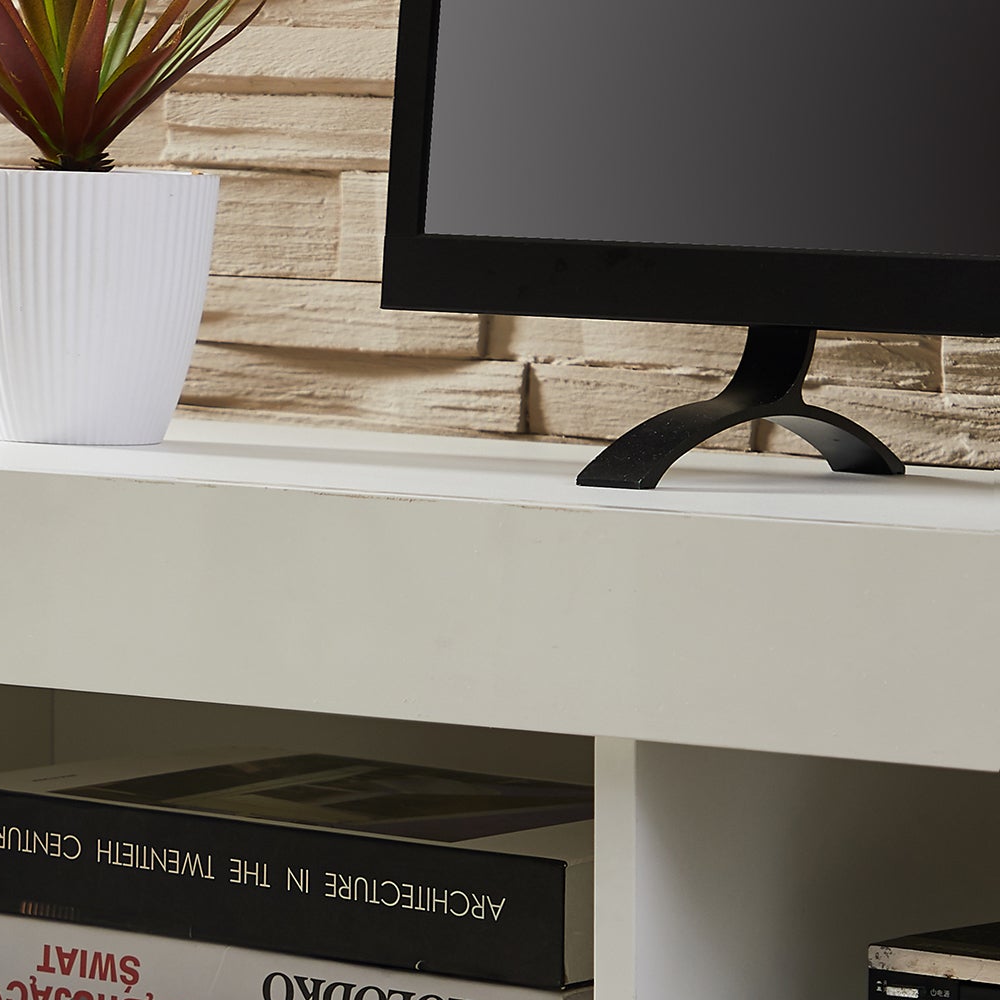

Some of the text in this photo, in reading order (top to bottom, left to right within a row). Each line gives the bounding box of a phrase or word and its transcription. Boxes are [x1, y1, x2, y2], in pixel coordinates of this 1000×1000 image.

[97, 838, 215, 880] TWENTIETH
[229, 858, 271, 888] THE
[287, 866, 309, 893] IN
[325, 872, 506, 921] ARCHITECTURE
[36, 944, 141, 993] ŚWIAT
